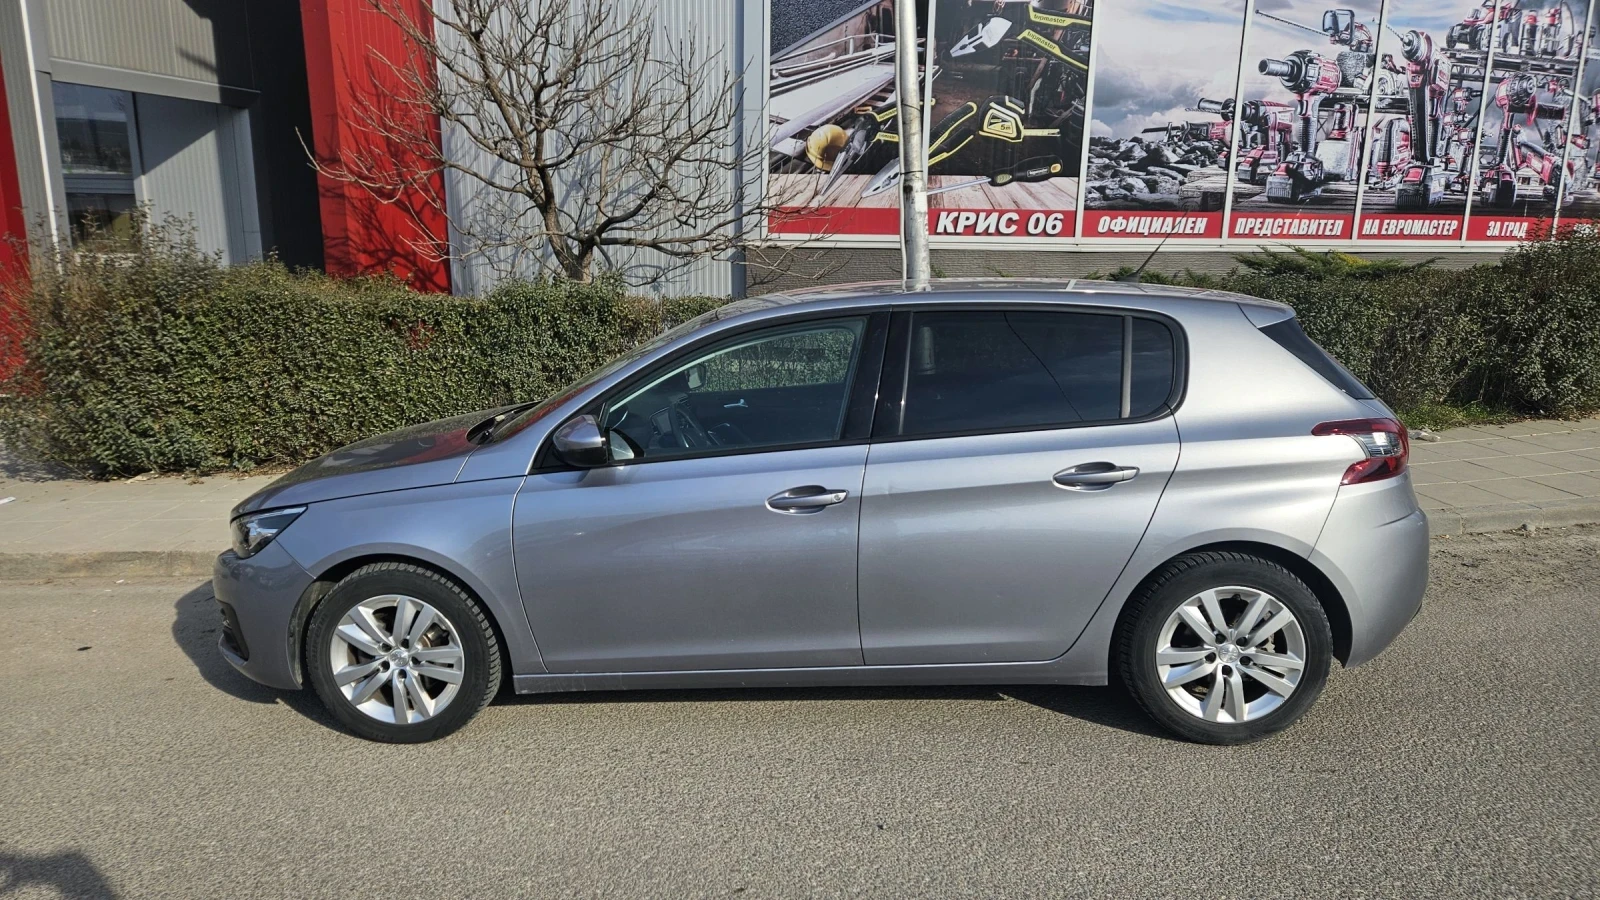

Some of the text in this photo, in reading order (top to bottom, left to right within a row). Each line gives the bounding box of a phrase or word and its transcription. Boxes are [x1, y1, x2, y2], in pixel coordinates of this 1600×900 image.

[936, 211, 1529, 238] КРИС 06 ОФИЦИАЛЕН ПРЕДСТАВИТЕЛ НА ЕВРОМАСТЕР ЗА ГРАД
